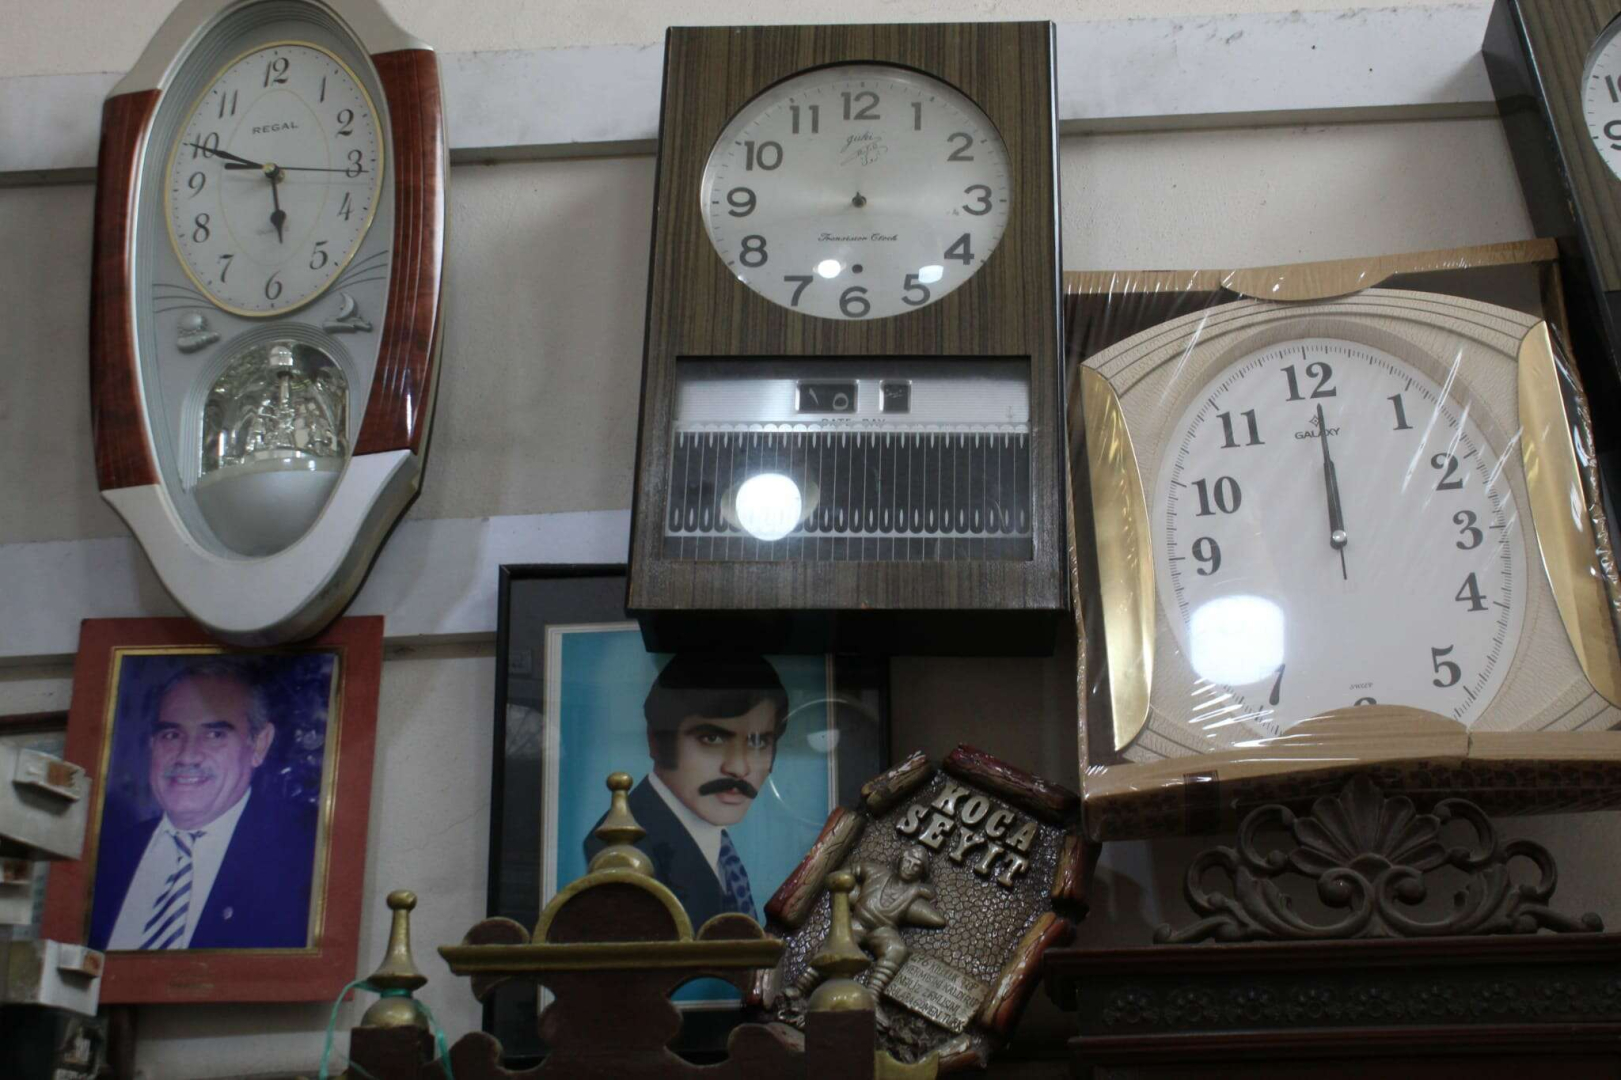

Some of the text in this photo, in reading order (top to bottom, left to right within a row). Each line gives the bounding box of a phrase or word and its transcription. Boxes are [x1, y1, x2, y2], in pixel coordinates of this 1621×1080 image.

[263, 57, 290, 88] 12
[218, 90, 239, 119] 11
[319, 76, 327, 103] 1
[789, 104, 820, 134] 11
[840, 90, 881, 121] 12
[910, 101, 922, 131] 1
[252, 121, 298, 135] REGAL
[336, 108, 354, 138] 2
[193, 132, 219, 160] 10
[744, 140, 784, 171] 10
[946, 131, 975, 162] 2
[346, 150, 363, 178] 3
[187, 171, 207, 197] 9
[962, 183, 993, 216] 3
[336, 192, 353, 221] 4
[726, 186, 757, 218] 9
[192, 213, 210, 243] 8
[309, 240, 328, 270] 5
[739, 234, 769, 268] 8
[943, 232, 975, 266] 4
[218, 254, 234, 283] 7
[264, 272, 283, 300] 6
[784, 275, 814, 307] 7
[901, 273, 931, 307] 5
[839, 285, 871, 319] 6
[1280, 361, 1337, 402] 12
[1386, 393, 1414, 431] 1
[1215, 408, 1265, 449] 11
[1294, 427, 1341, 440] GALAXY
[1430, 452, 1464, 491] 2
[1191, 476, 1242, 517] 10
[1452, 510, 1484, 551] 3
[1191, 536, 1222, 576] 9
[1454, 572, 1489, 612] 4
[1430, 644, 1463, 688] 5
[931, 782, 1037, 851] KOCA
